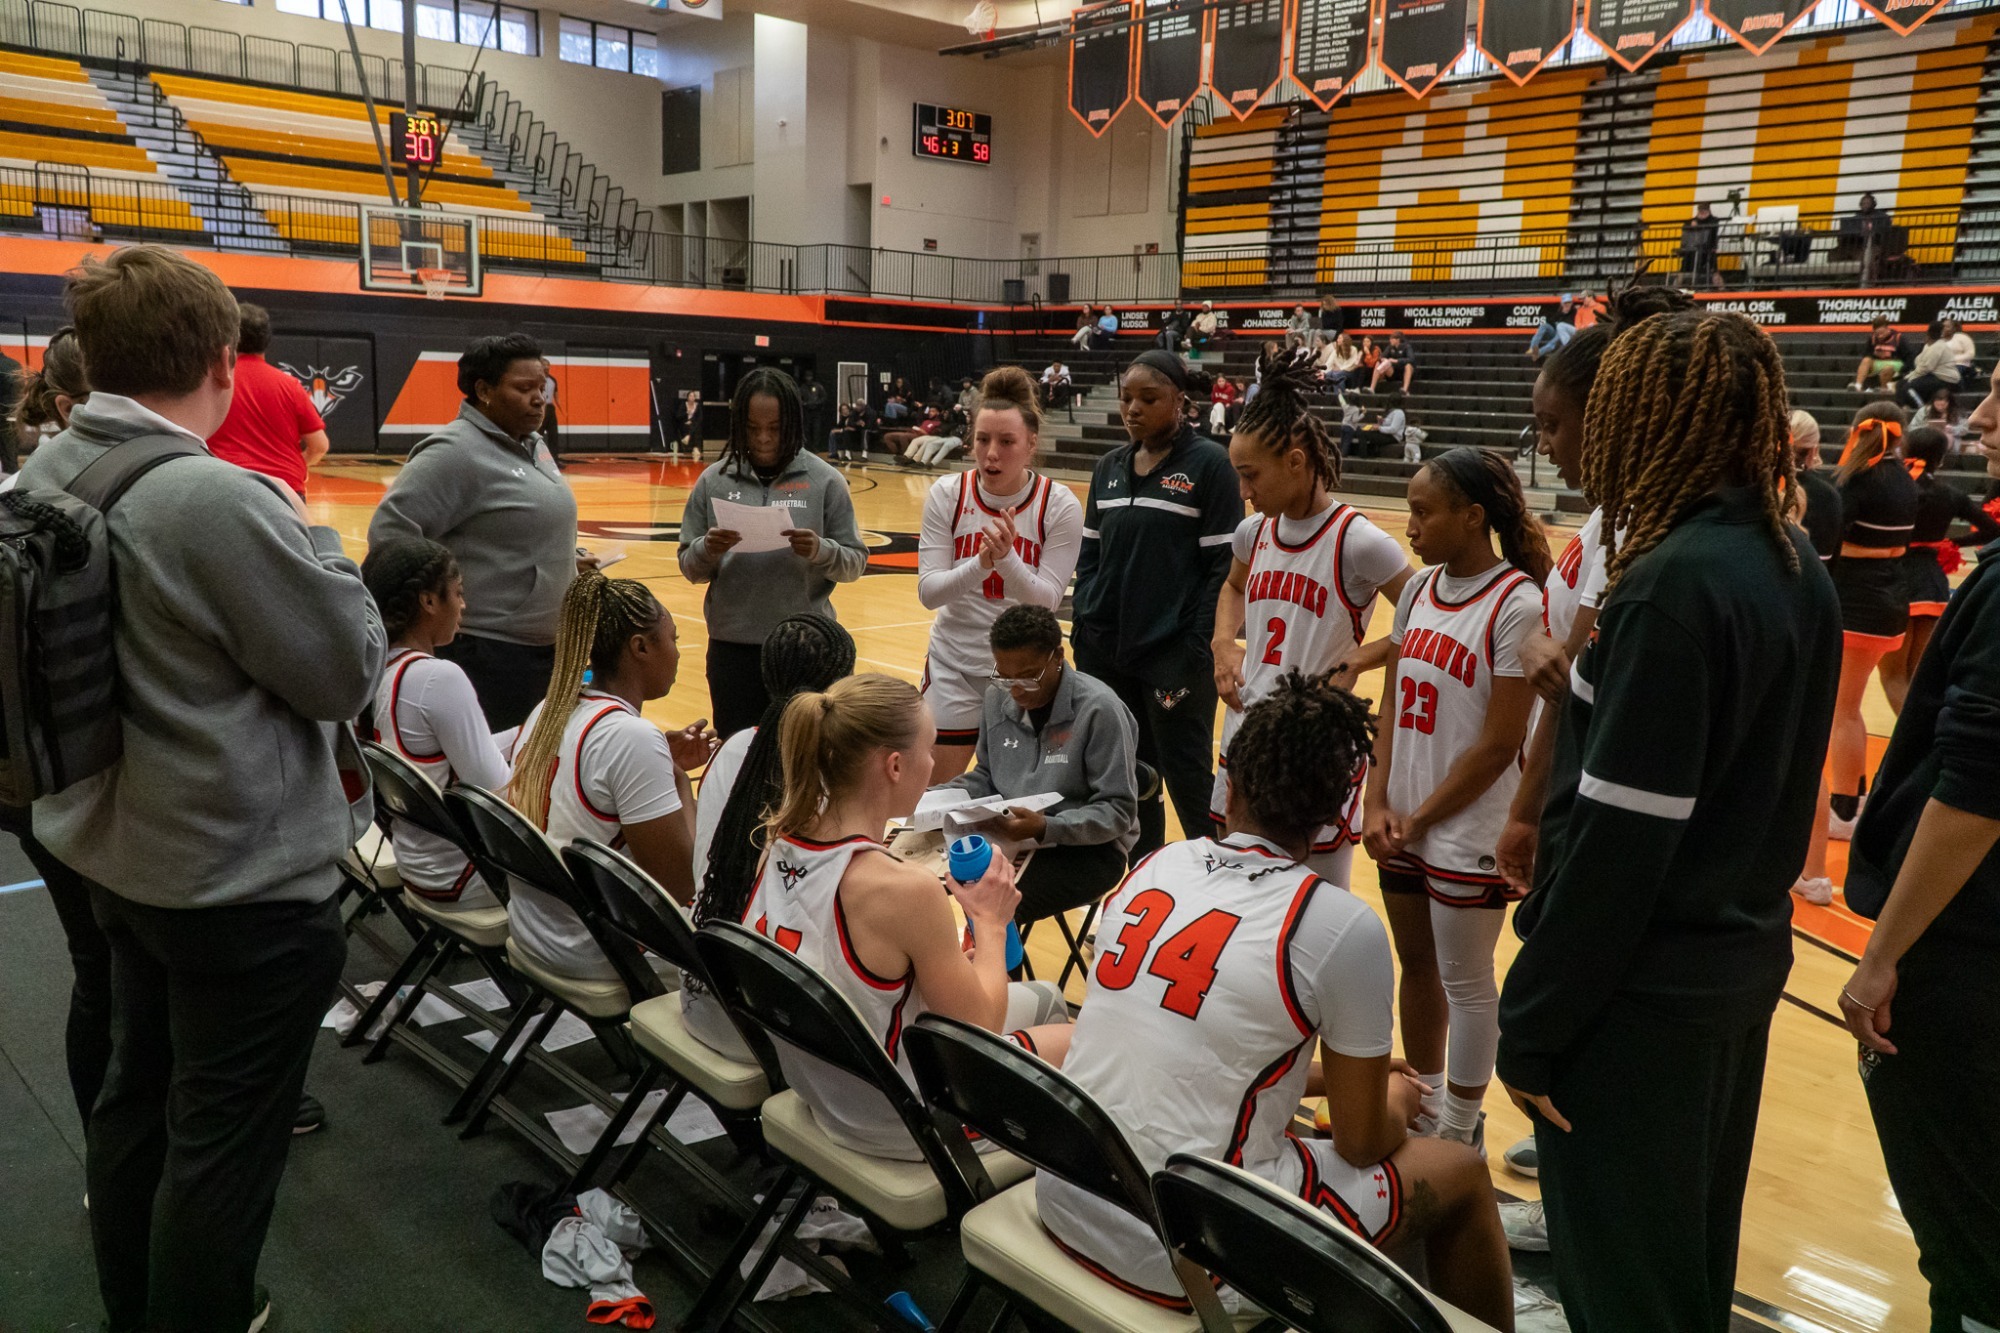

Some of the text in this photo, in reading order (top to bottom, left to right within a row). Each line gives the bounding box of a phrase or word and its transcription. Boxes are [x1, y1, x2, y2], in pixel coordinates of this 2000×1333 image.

[1408, 7, 1424, 16] ELITE
[1425, 3, 1445, 13] EIGHT
[1622, 6, 1647, 15] SWEET
[1648, 1, 1678, 12] SIXTEEN
[1621, 15, 1641, 25] ELITE
[1642, 12, 1665, 21] EIGHT
[1740, 12, 1785, 33] AUM
[946, 109, 973, 129] 3:07
[408, 117, 439, 136] 3:07
[405, 133, 433, 161] 30
[923, 136, 939, 153] 46
[952, 141, 959, 155] 3
[973, 143, 989, 160] 58
[1706, 300, 1775, 312] HELGA OSK
[1817, 298, 1907, 312] THORHALLUR
[1945, 297, 1993, 309] ALLEN
[1121, 311, 1149, 319] LINDSEY
[1258, 309, 1284, 318] VIGNIR
[1361, 308, 1386, 317] KATIE
[1404, 306, 1485, 317] NICOLAS PINONES
[1513, 305, 1541, 316] CODY
[1819, 311, 1900, 323] HINRIKSSON
[1937, 309, 1998, 322] PONDER
[1121, 320, 1149, 328] HUDSON
[1242, 319, 1292, 328] JOHANNESSO
[1360, 318, 1386, 327] SPAIN
[1414, 317, 1473, 327] HALTENHOFF
[1506, 316, 1547, 326] SHIELDS
[771, 500, 807, 508] BASKETBALL
[1247, 570, 1328, 619] ARHAWKS
[1261, 616, 1287, 666] 2
[1399, 628, 1477, 689] ARHAWKS
[1399, 675, 1439, 736] 23
[1096, 888, 1243, 1021] 34
